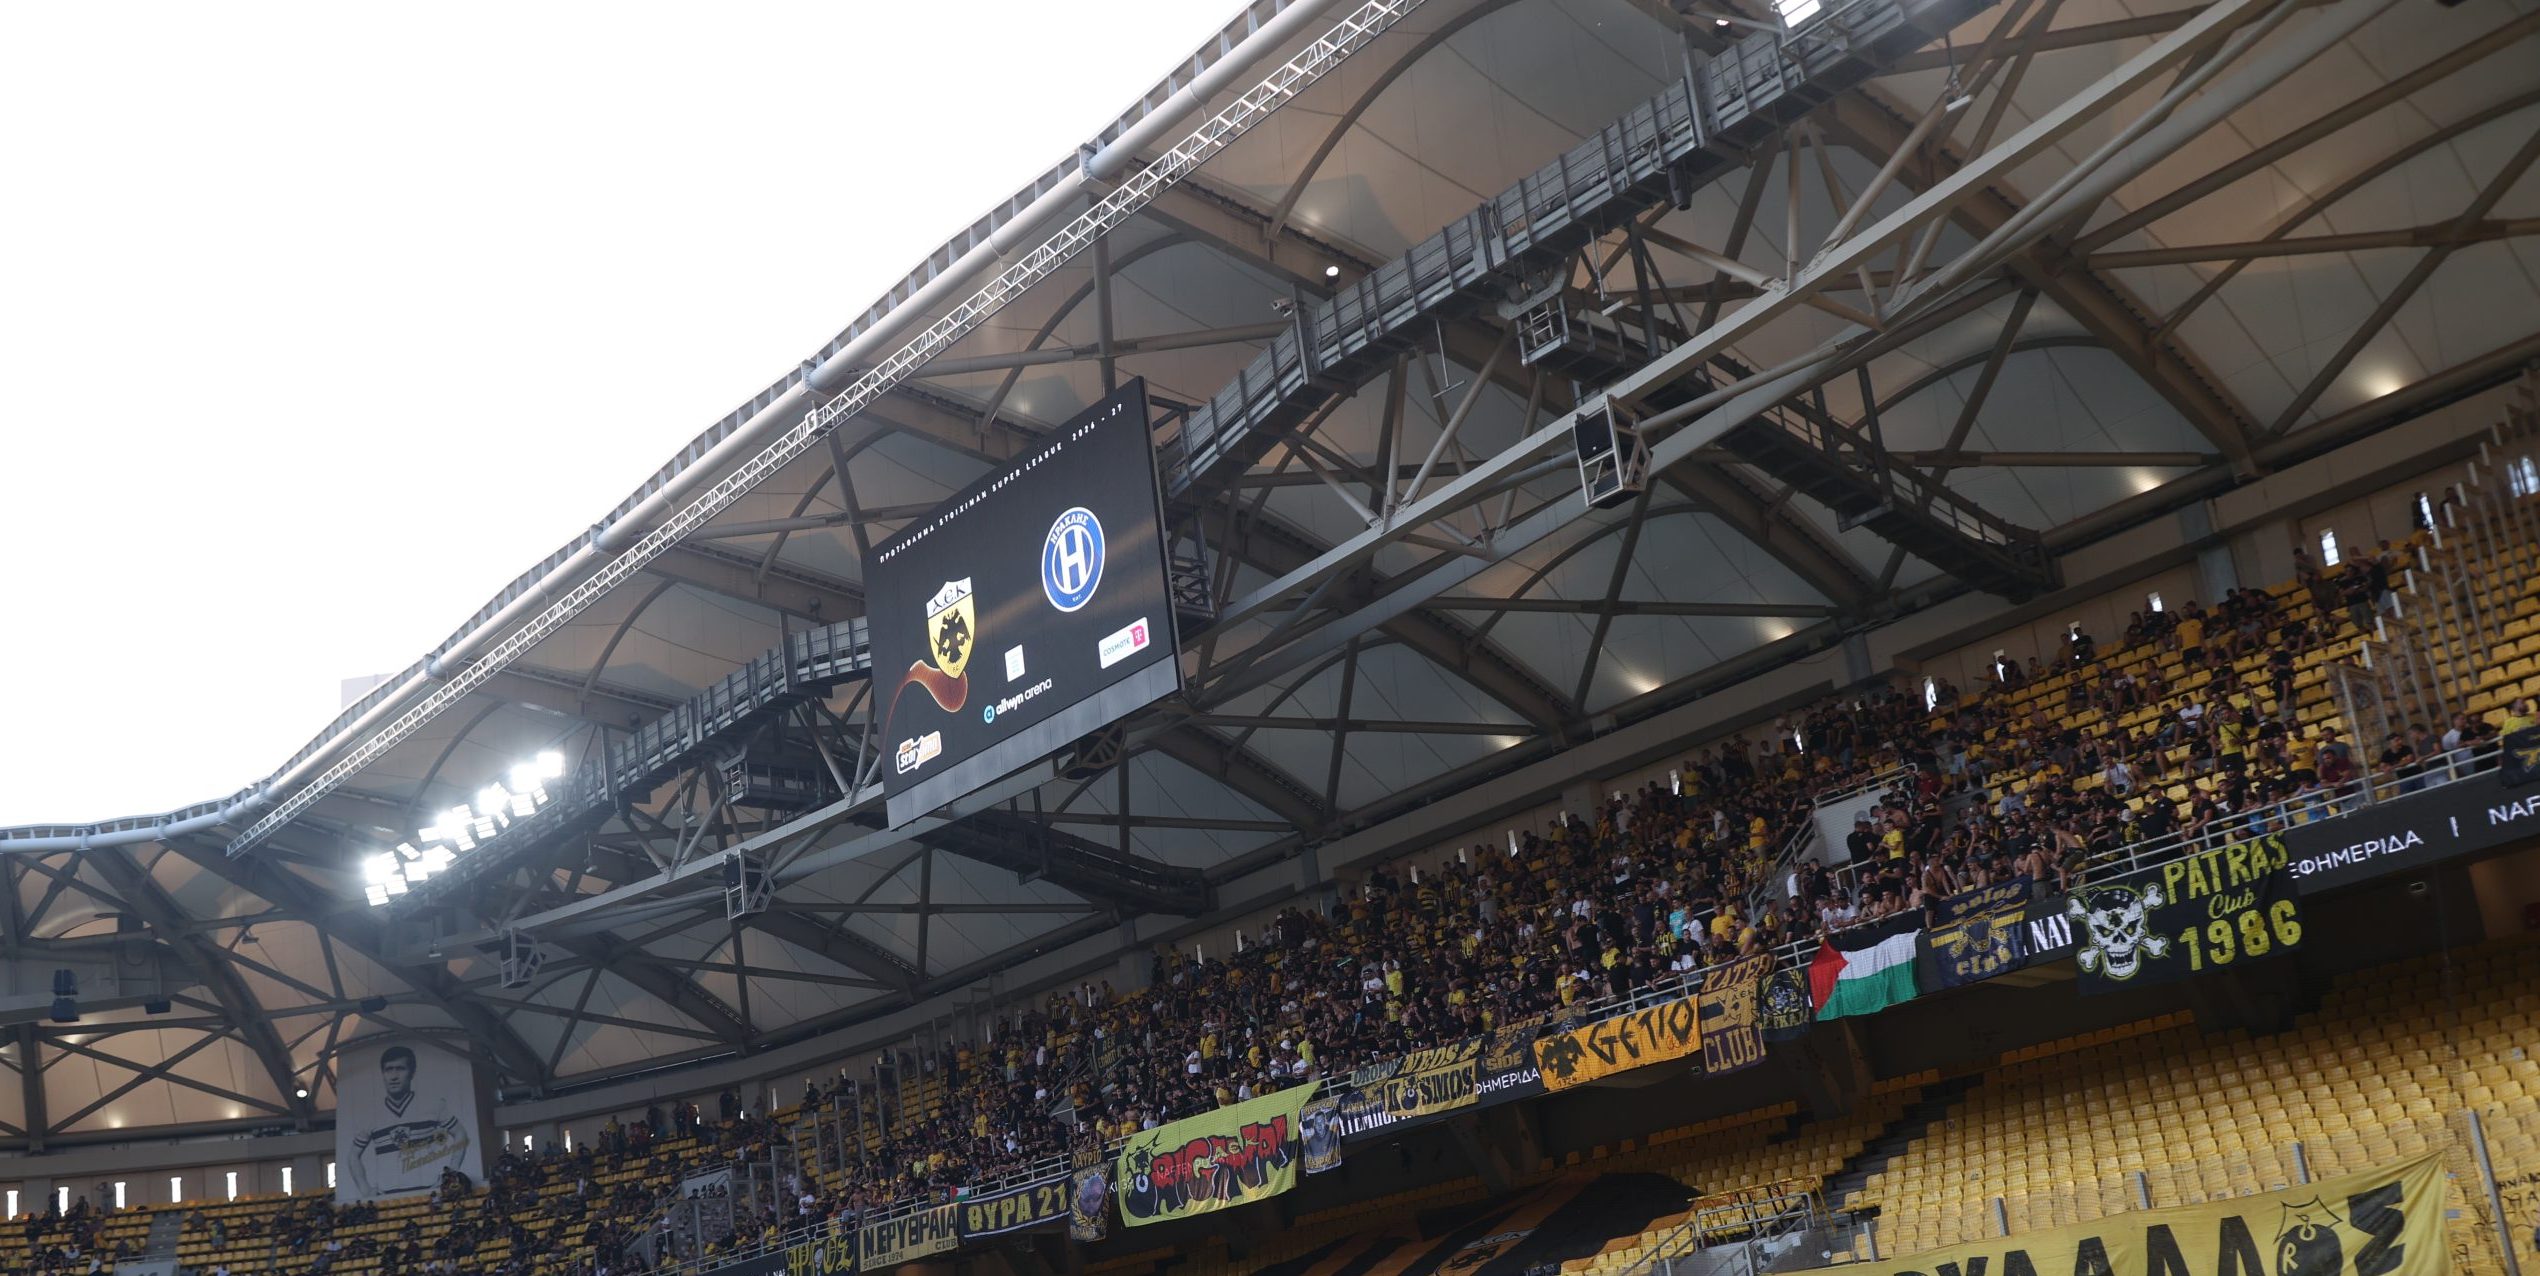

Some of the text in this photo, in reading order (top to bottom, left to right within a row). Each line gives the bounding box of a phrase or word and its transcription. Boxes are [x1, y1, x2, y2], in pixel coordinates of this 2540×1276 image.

[939, 490, 987, 526] STOIXIMAN
[992, 469, 1021, 492] SUPER
[1026, 442, 1062, 471] LEAGUE
[995, 693, 1024, 715] allwyn
[1024, 678, 1053, 700] arena
[2163, 831, 2290, 905] PATRAS
[2208, 886, 2257, 920] Club
[2178, 899, 2302, 971] 1986
[1703, 1027, 1758, 1073] CLUB
[967, 1193, 1032, 1232] ΘΥΡΑ
[1036, 1183, 1067, 1217] 21
[864, 1256, 886, 1270] SINCE
[935, 1237, 957, 1250] CLUB
